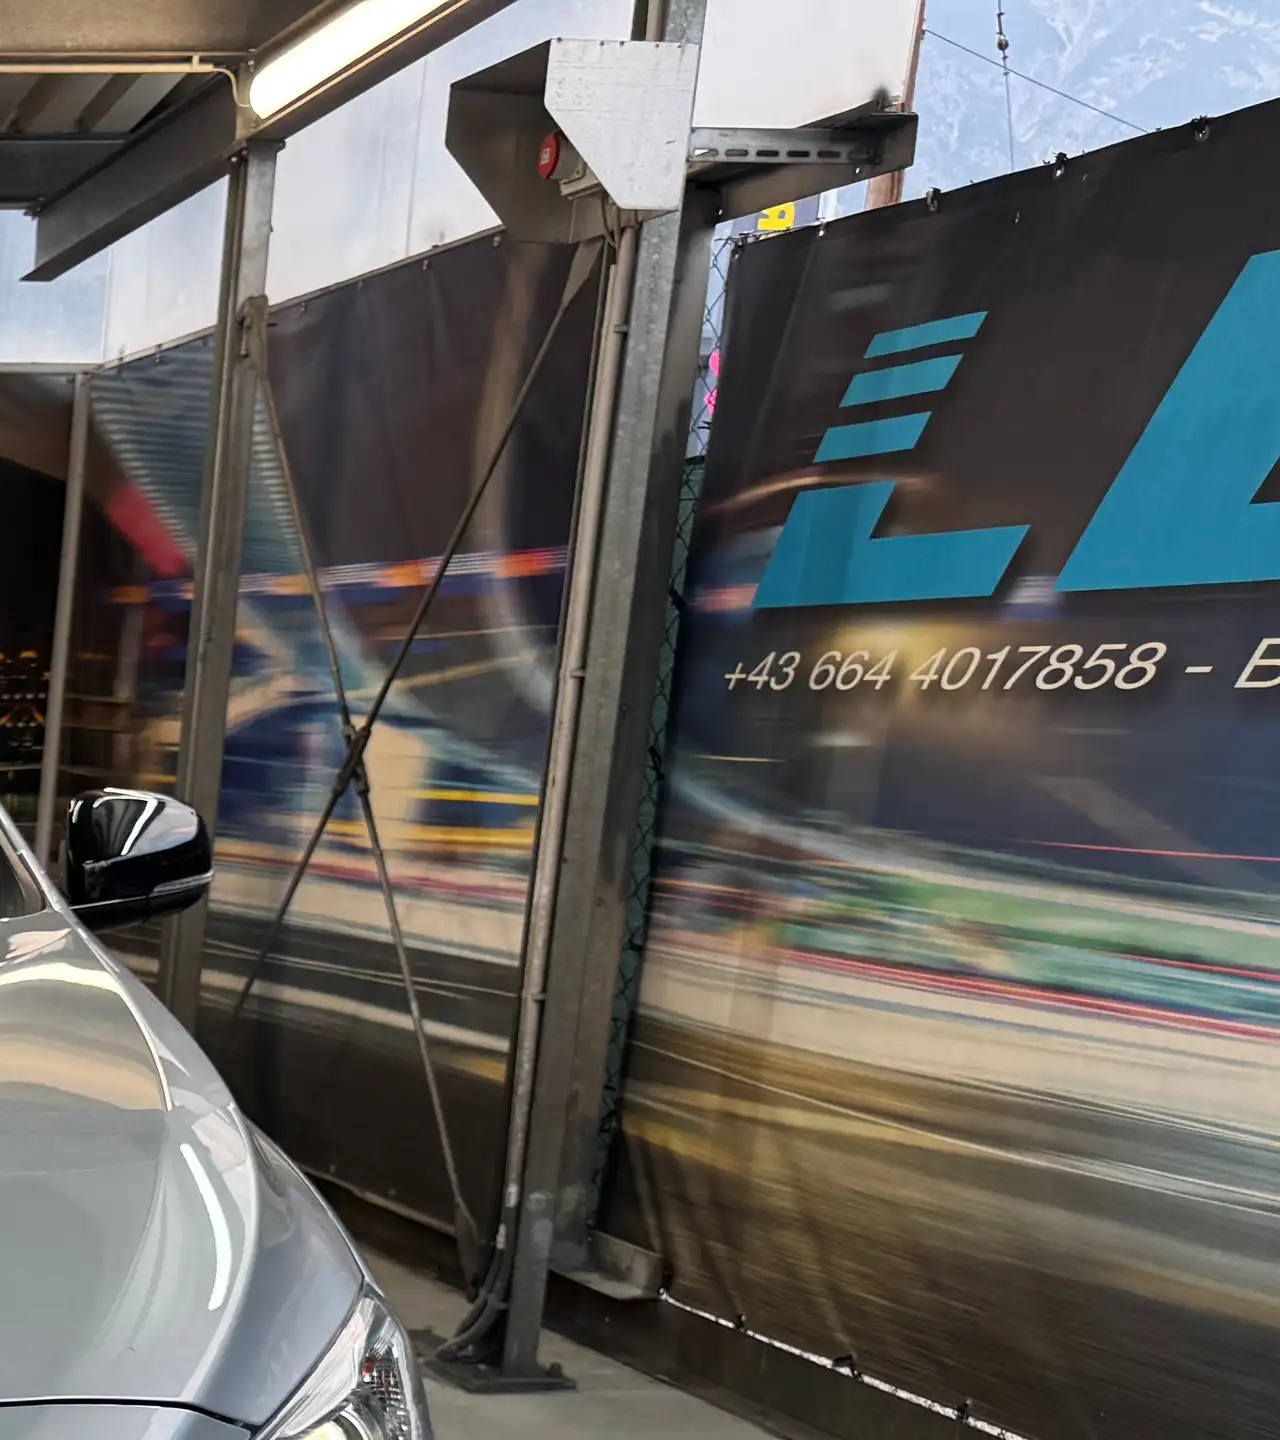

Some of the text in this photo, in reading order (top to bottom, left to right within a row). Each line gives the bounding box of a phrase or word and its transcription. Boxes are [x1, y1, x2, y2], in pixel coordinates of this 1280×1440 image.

[724, 651, 801, 691] +43
[808, 650, 899, 691] 664
[908, 641, 1168, 691] 4017858
